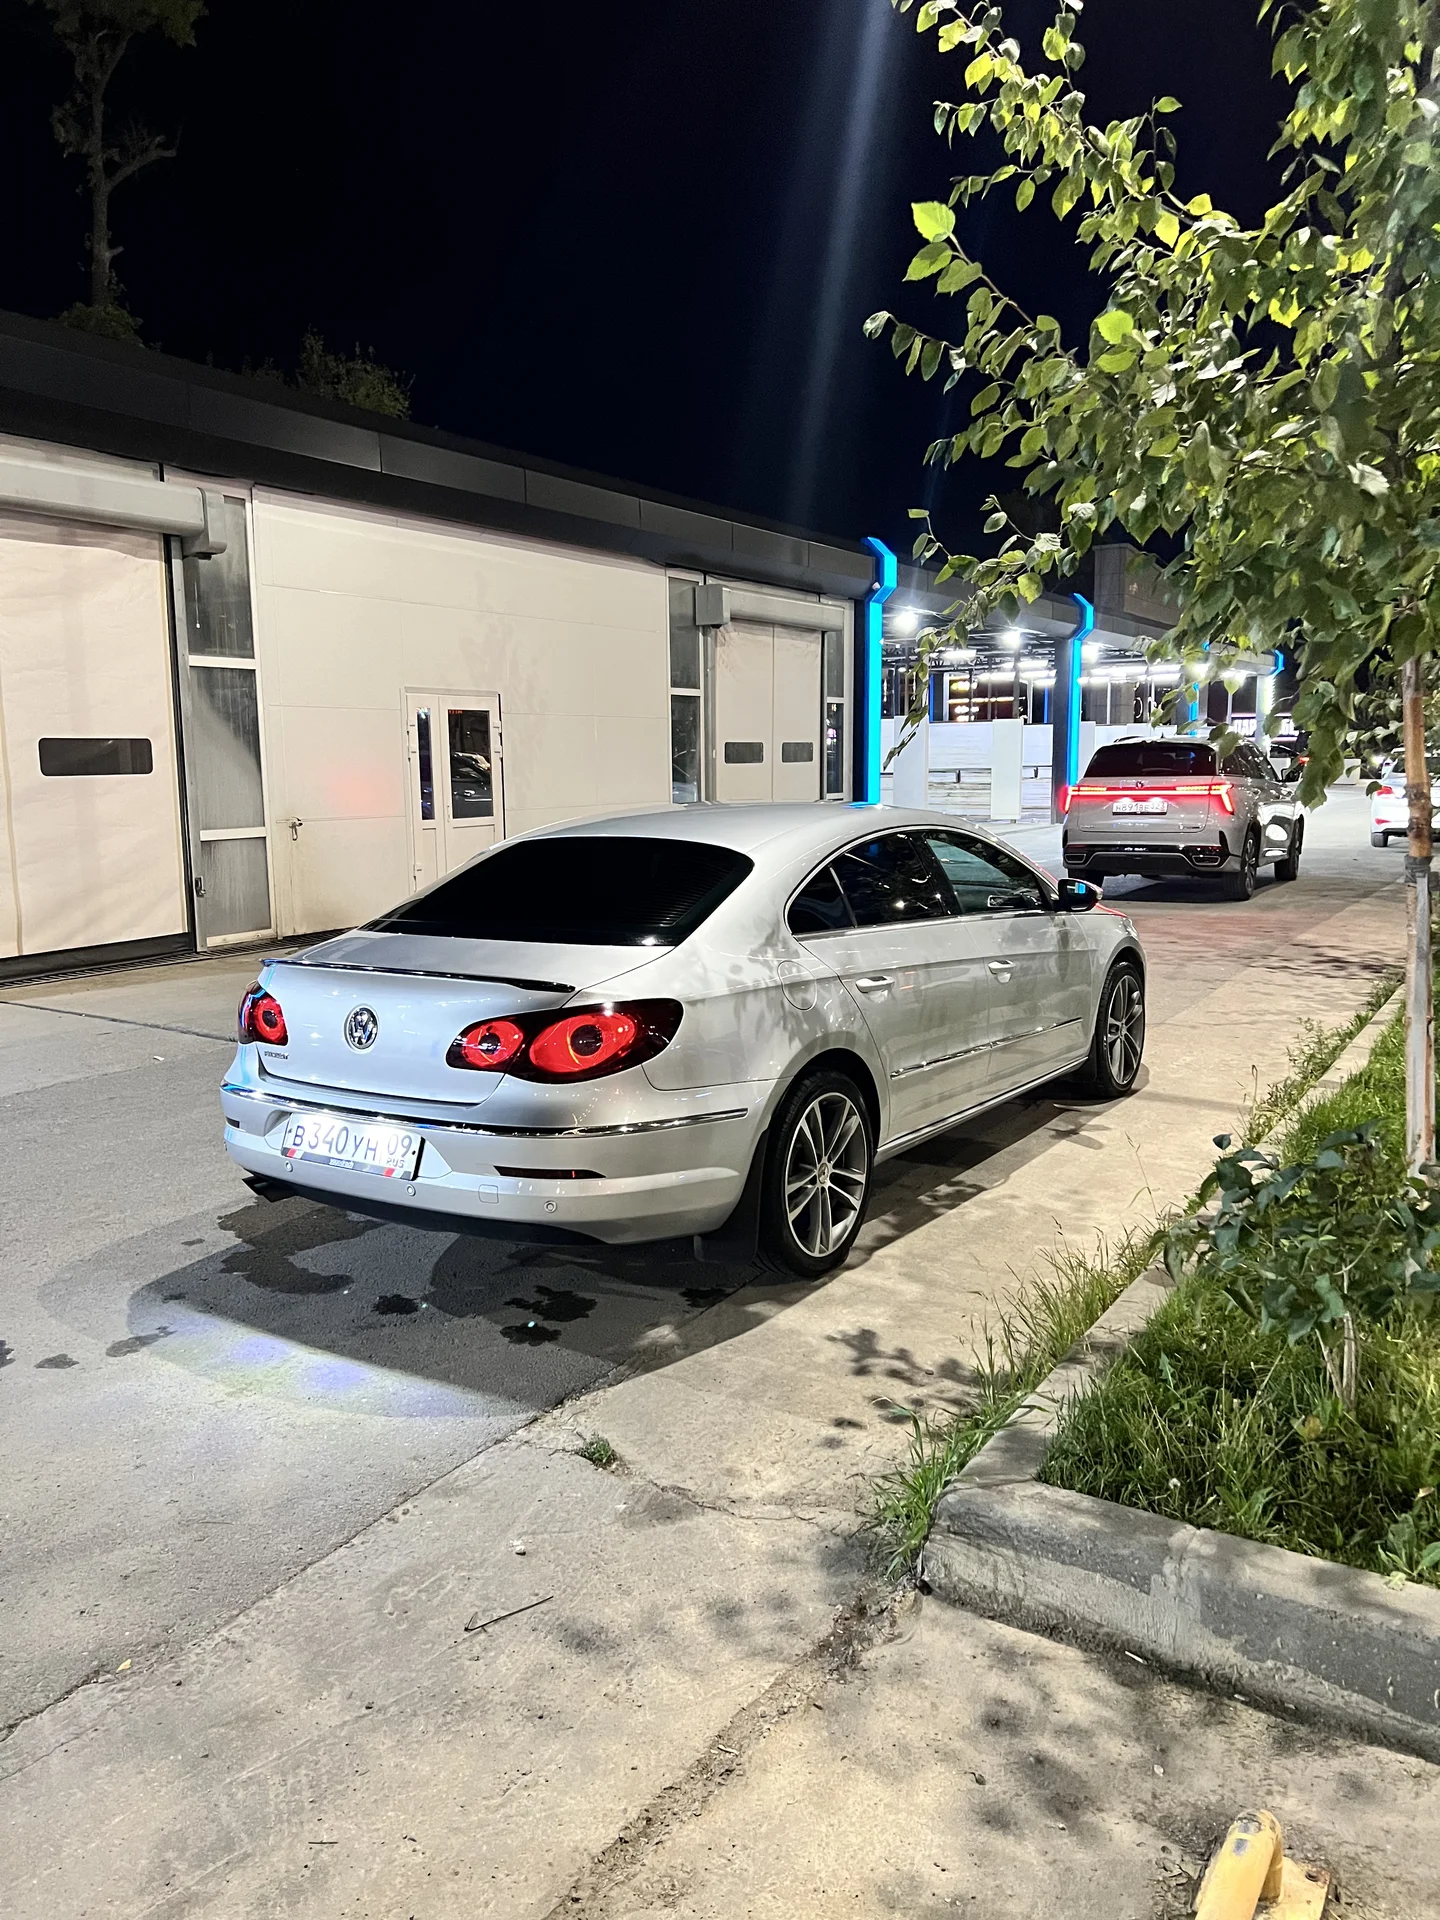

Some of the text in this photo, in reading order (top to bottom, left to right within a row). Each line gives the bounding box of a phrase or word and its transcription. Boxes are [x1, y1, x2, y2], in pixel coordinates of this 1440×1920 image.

[292, 1122, 413, 1162] В340УН 09
[386, 1157, 405, 1169] RUS
